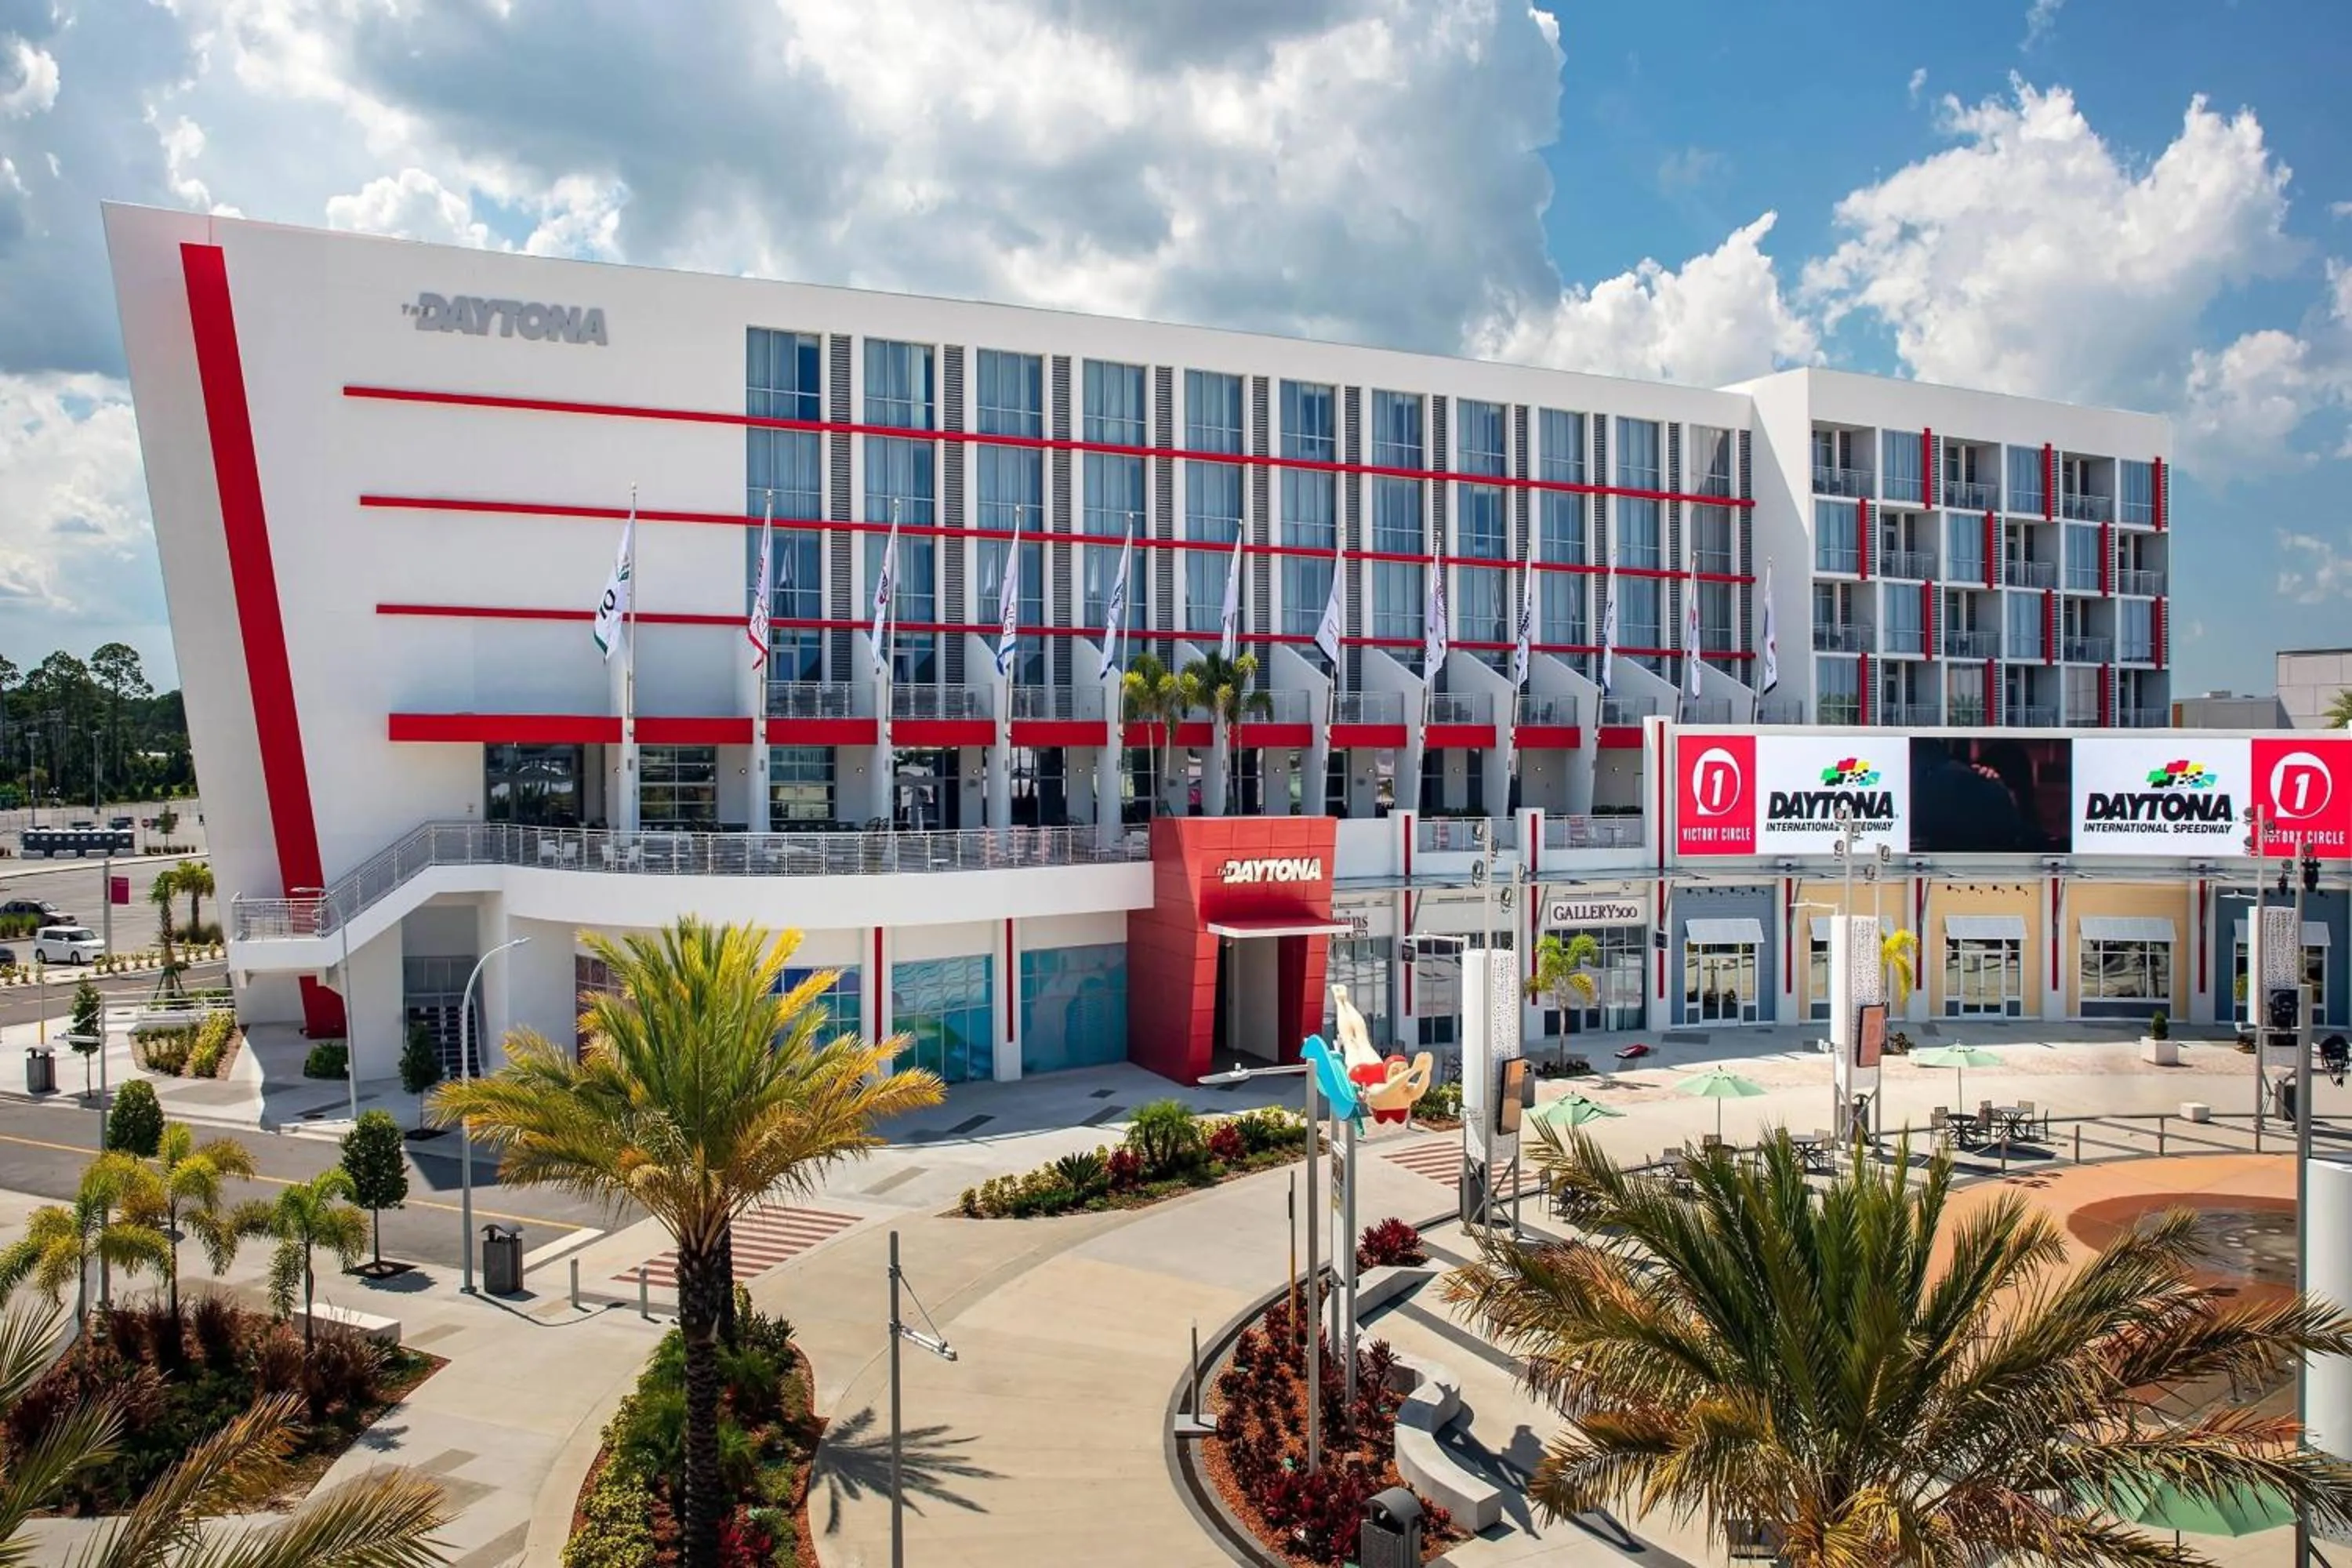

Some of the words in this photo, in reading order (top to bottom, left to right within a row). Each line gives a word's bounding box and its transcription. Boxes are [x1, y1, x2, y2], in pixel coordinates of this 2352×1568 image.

[416, 292, 608, 346] DAYTONA
[1767, 791, 1894, 819] DAYTONA
[2085, 793, 2233, 822] DAYTONA
[1682, 827, 1719, 841] VICTORY
[1721, 827, 1751, 841] CIRCLE
[2084, 823, 2169, 833] INTERNATIONAL
[2173, 824, 2232, 834] SPEEDWAY
[2262, 830, 2303, 844] CTORY
[2307, 830, 2345, 844] CIRCLE
[1223, 858, 1322, 883] DAYTONA
